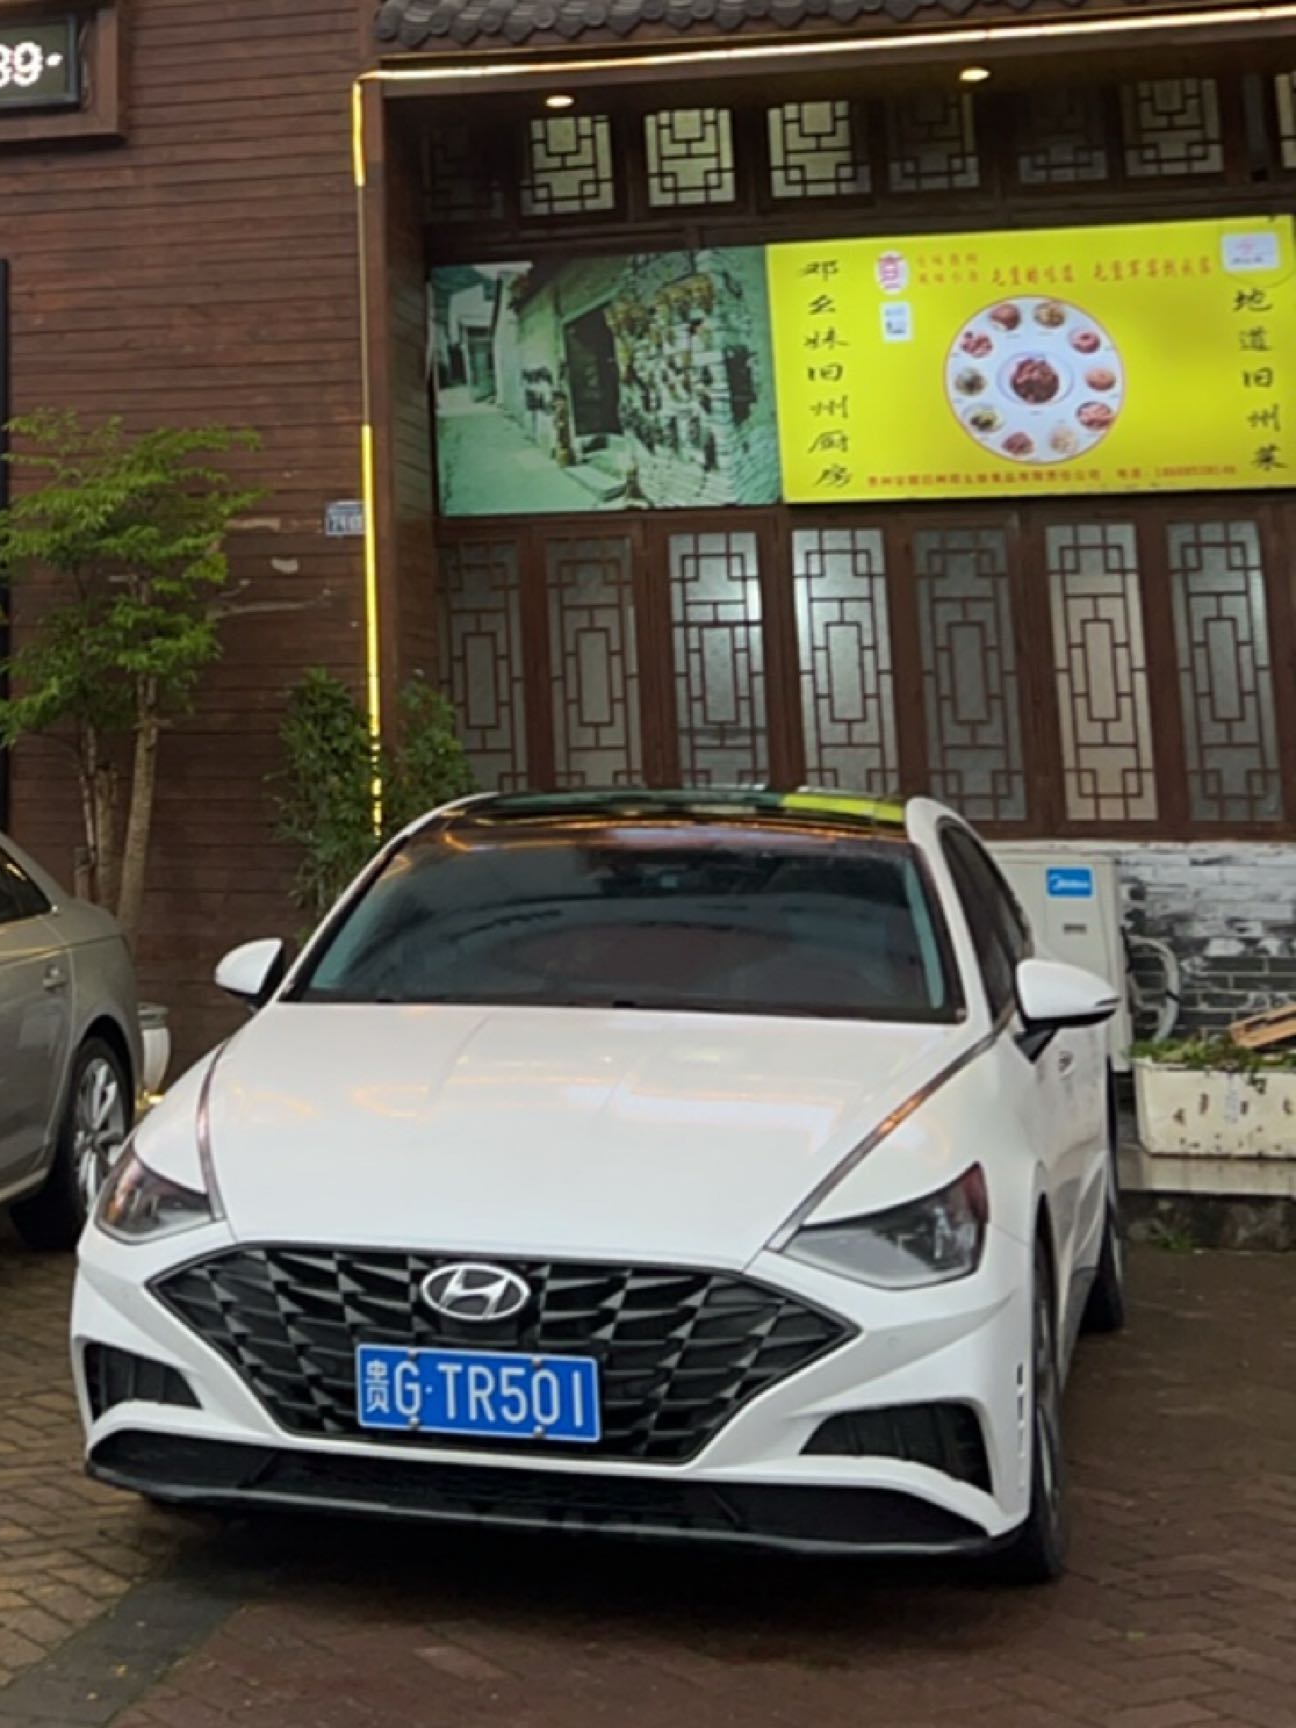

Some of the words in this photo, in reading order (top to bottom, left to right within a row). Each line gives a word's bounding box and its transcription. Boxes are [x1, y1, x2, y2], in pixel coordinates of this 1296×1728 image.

[1233, 287, 1289, 472] 地道旧州菜
